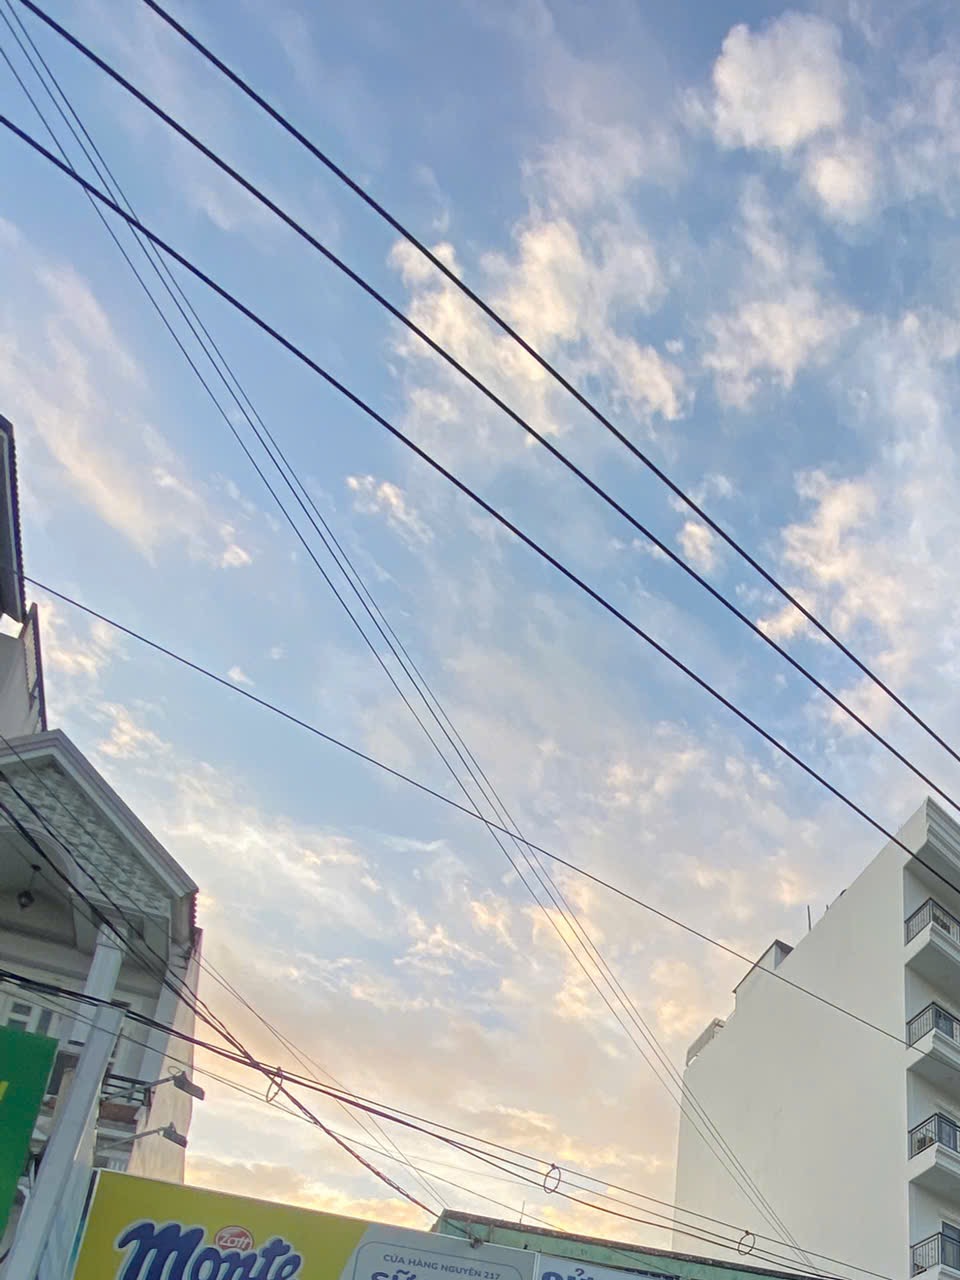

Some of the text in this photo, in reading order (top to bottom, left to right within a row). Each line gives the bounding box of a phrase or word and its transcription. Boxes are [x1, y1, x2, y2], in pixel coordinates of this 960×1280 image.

[219, 1230, 250, 1250] Zott
[408, 1257, 438, 1271] HÀNG
[440, 1264, 482, 1278] NGUYÊN
[484, 1271, 501, 1280] 217
